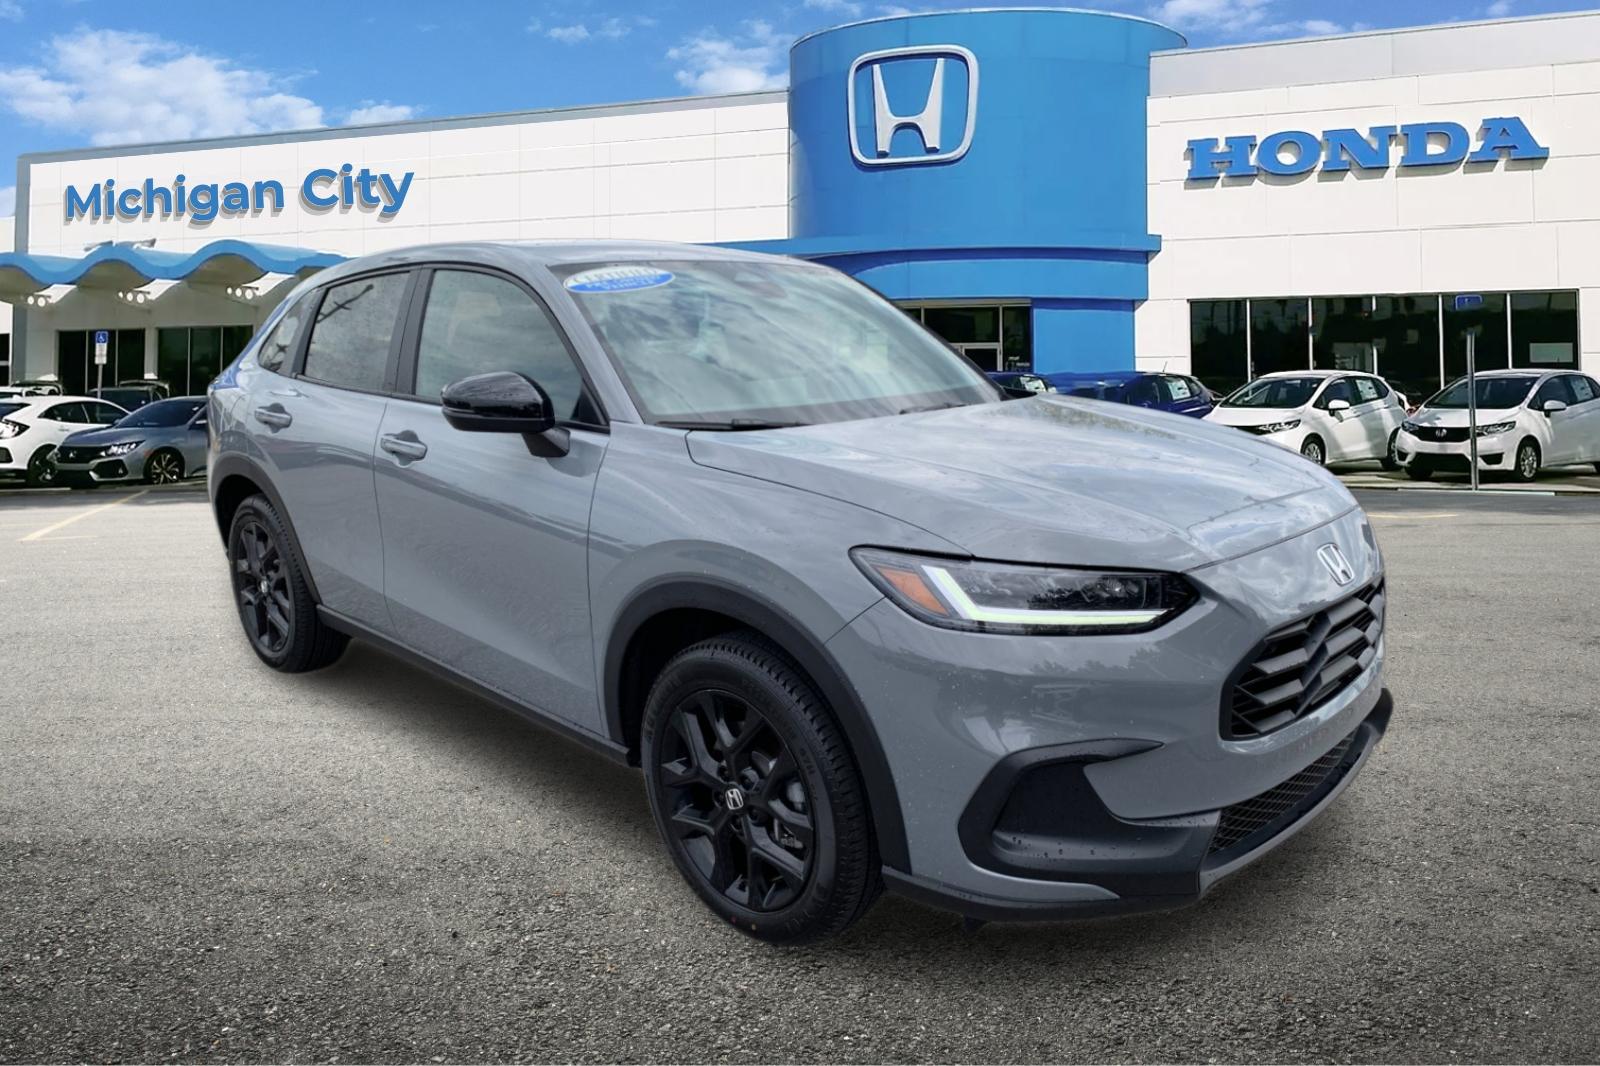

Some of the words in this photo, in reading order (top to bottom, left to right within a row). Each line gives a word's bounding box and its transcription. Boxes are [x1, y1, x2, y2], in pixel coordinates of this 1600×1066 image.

[1186, 116, 1549, 182] HONDA
[65, 173, 285, 223] Michigan
[302, 162, 414, 215] City
